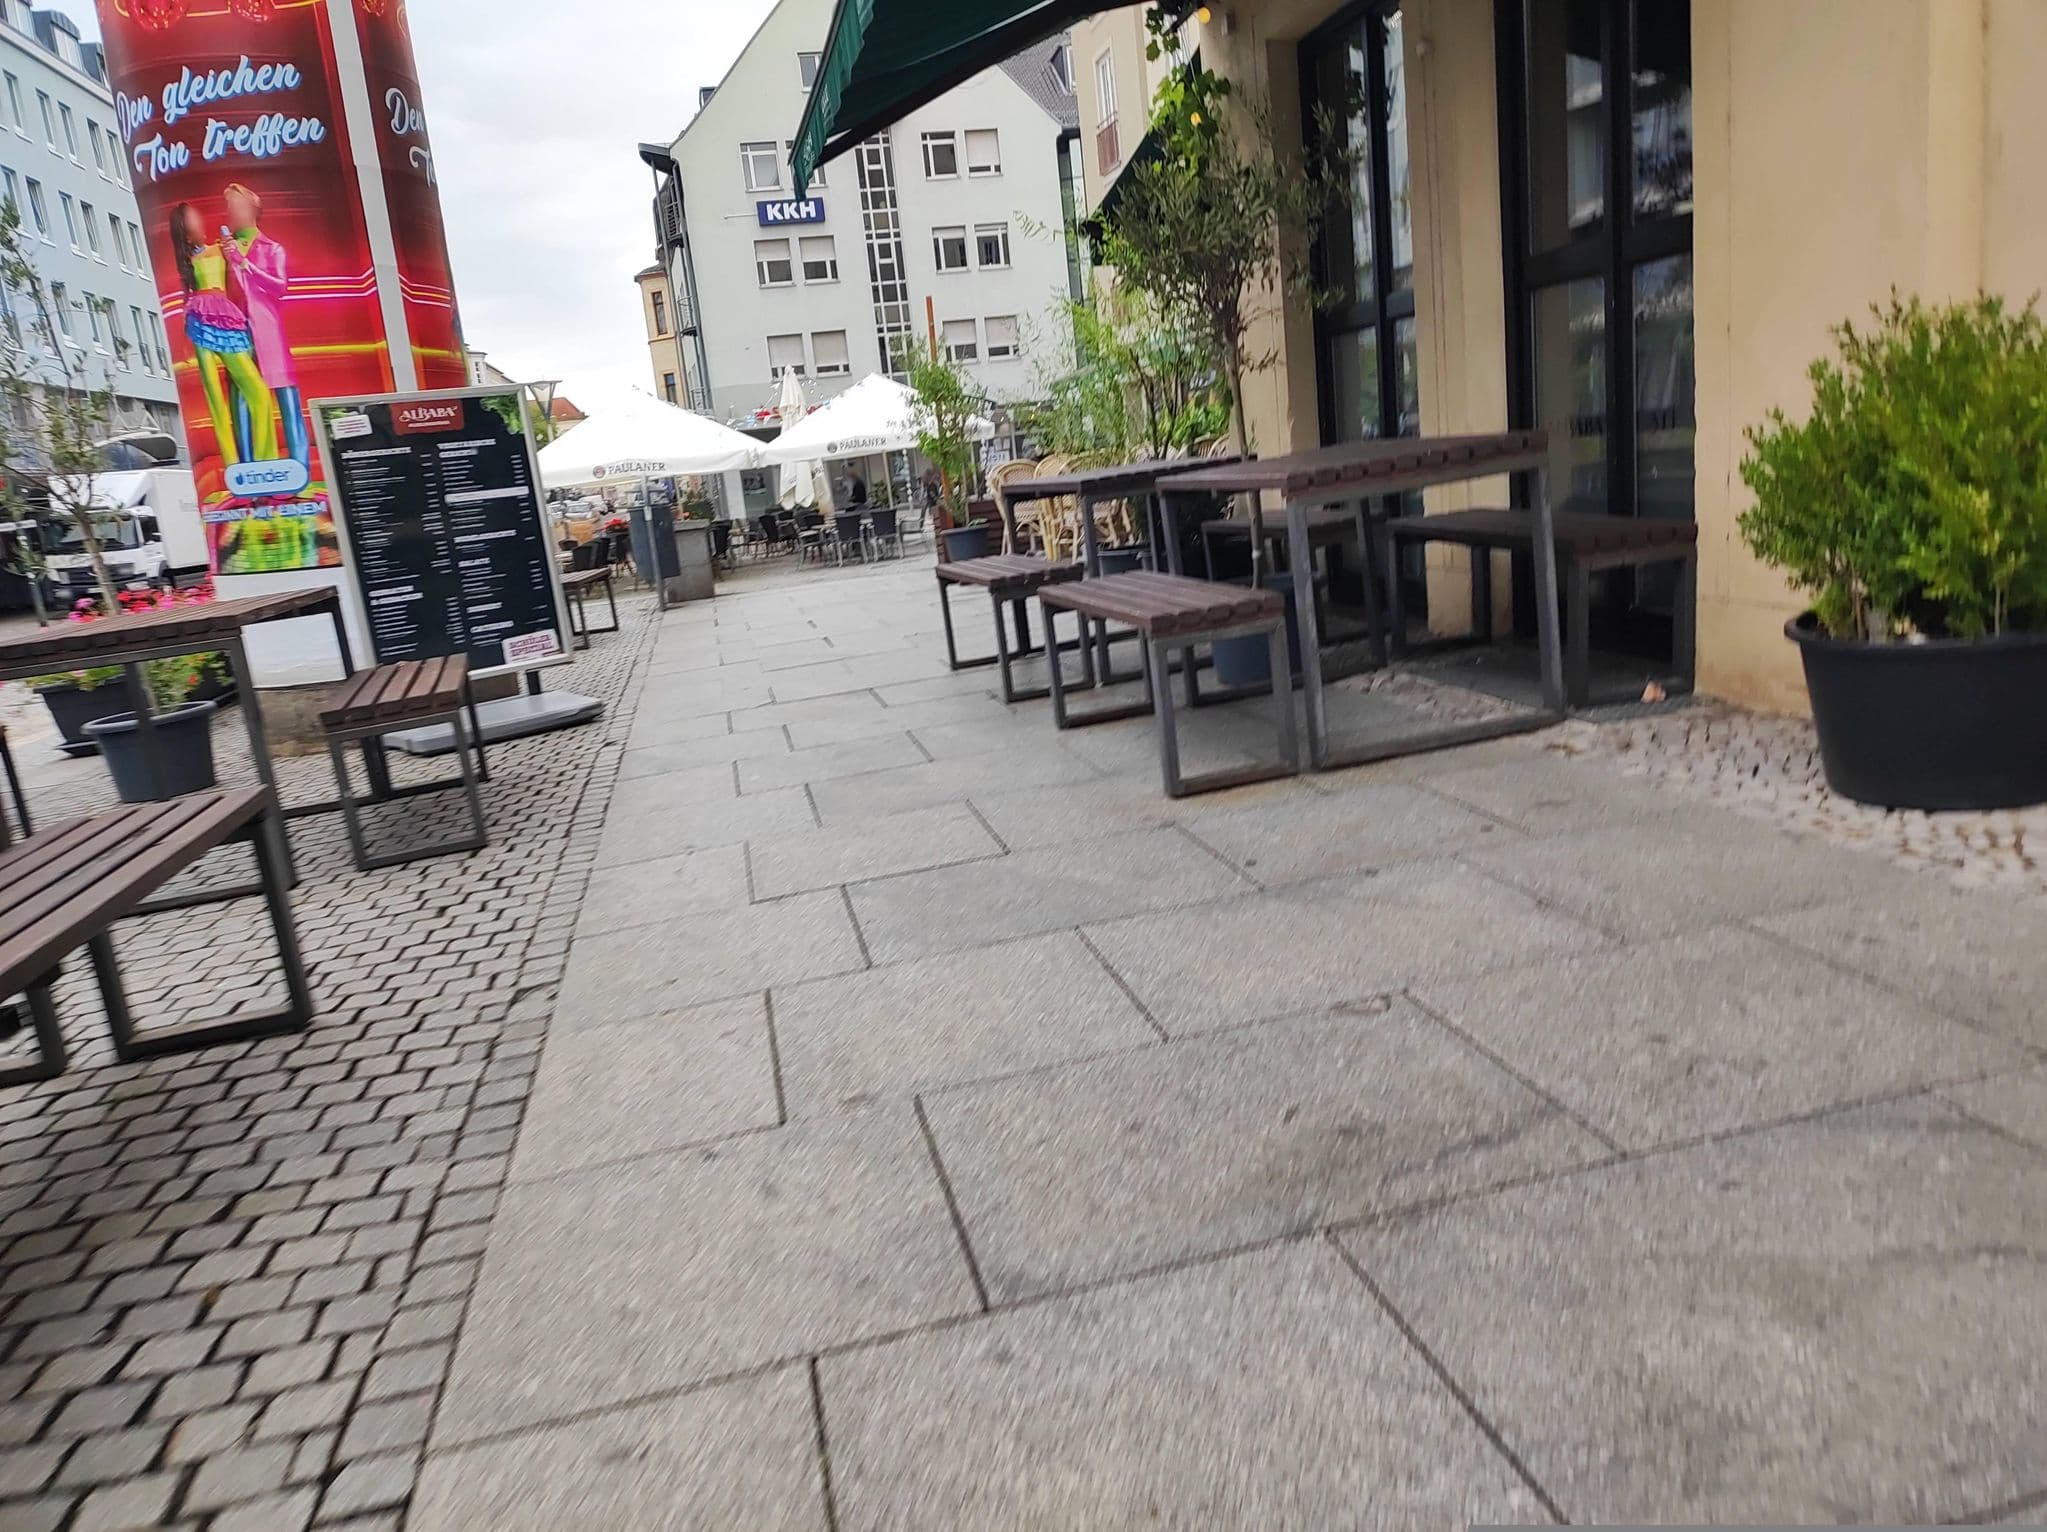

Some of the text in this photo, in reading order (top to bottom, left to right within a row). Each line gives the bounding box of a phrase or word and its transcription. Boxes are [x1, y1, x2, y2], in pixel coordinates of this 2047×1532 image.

[116, 54, 301, 145] Den gleichen
[133, 112, 326, 182] Ton treffen
[766, 200, 817, 221] KKH
[840, 437, 887, 449] PAULANER
[246, 467, 292, 485] tinder
[608, 462, 667, 475] PAULANER
